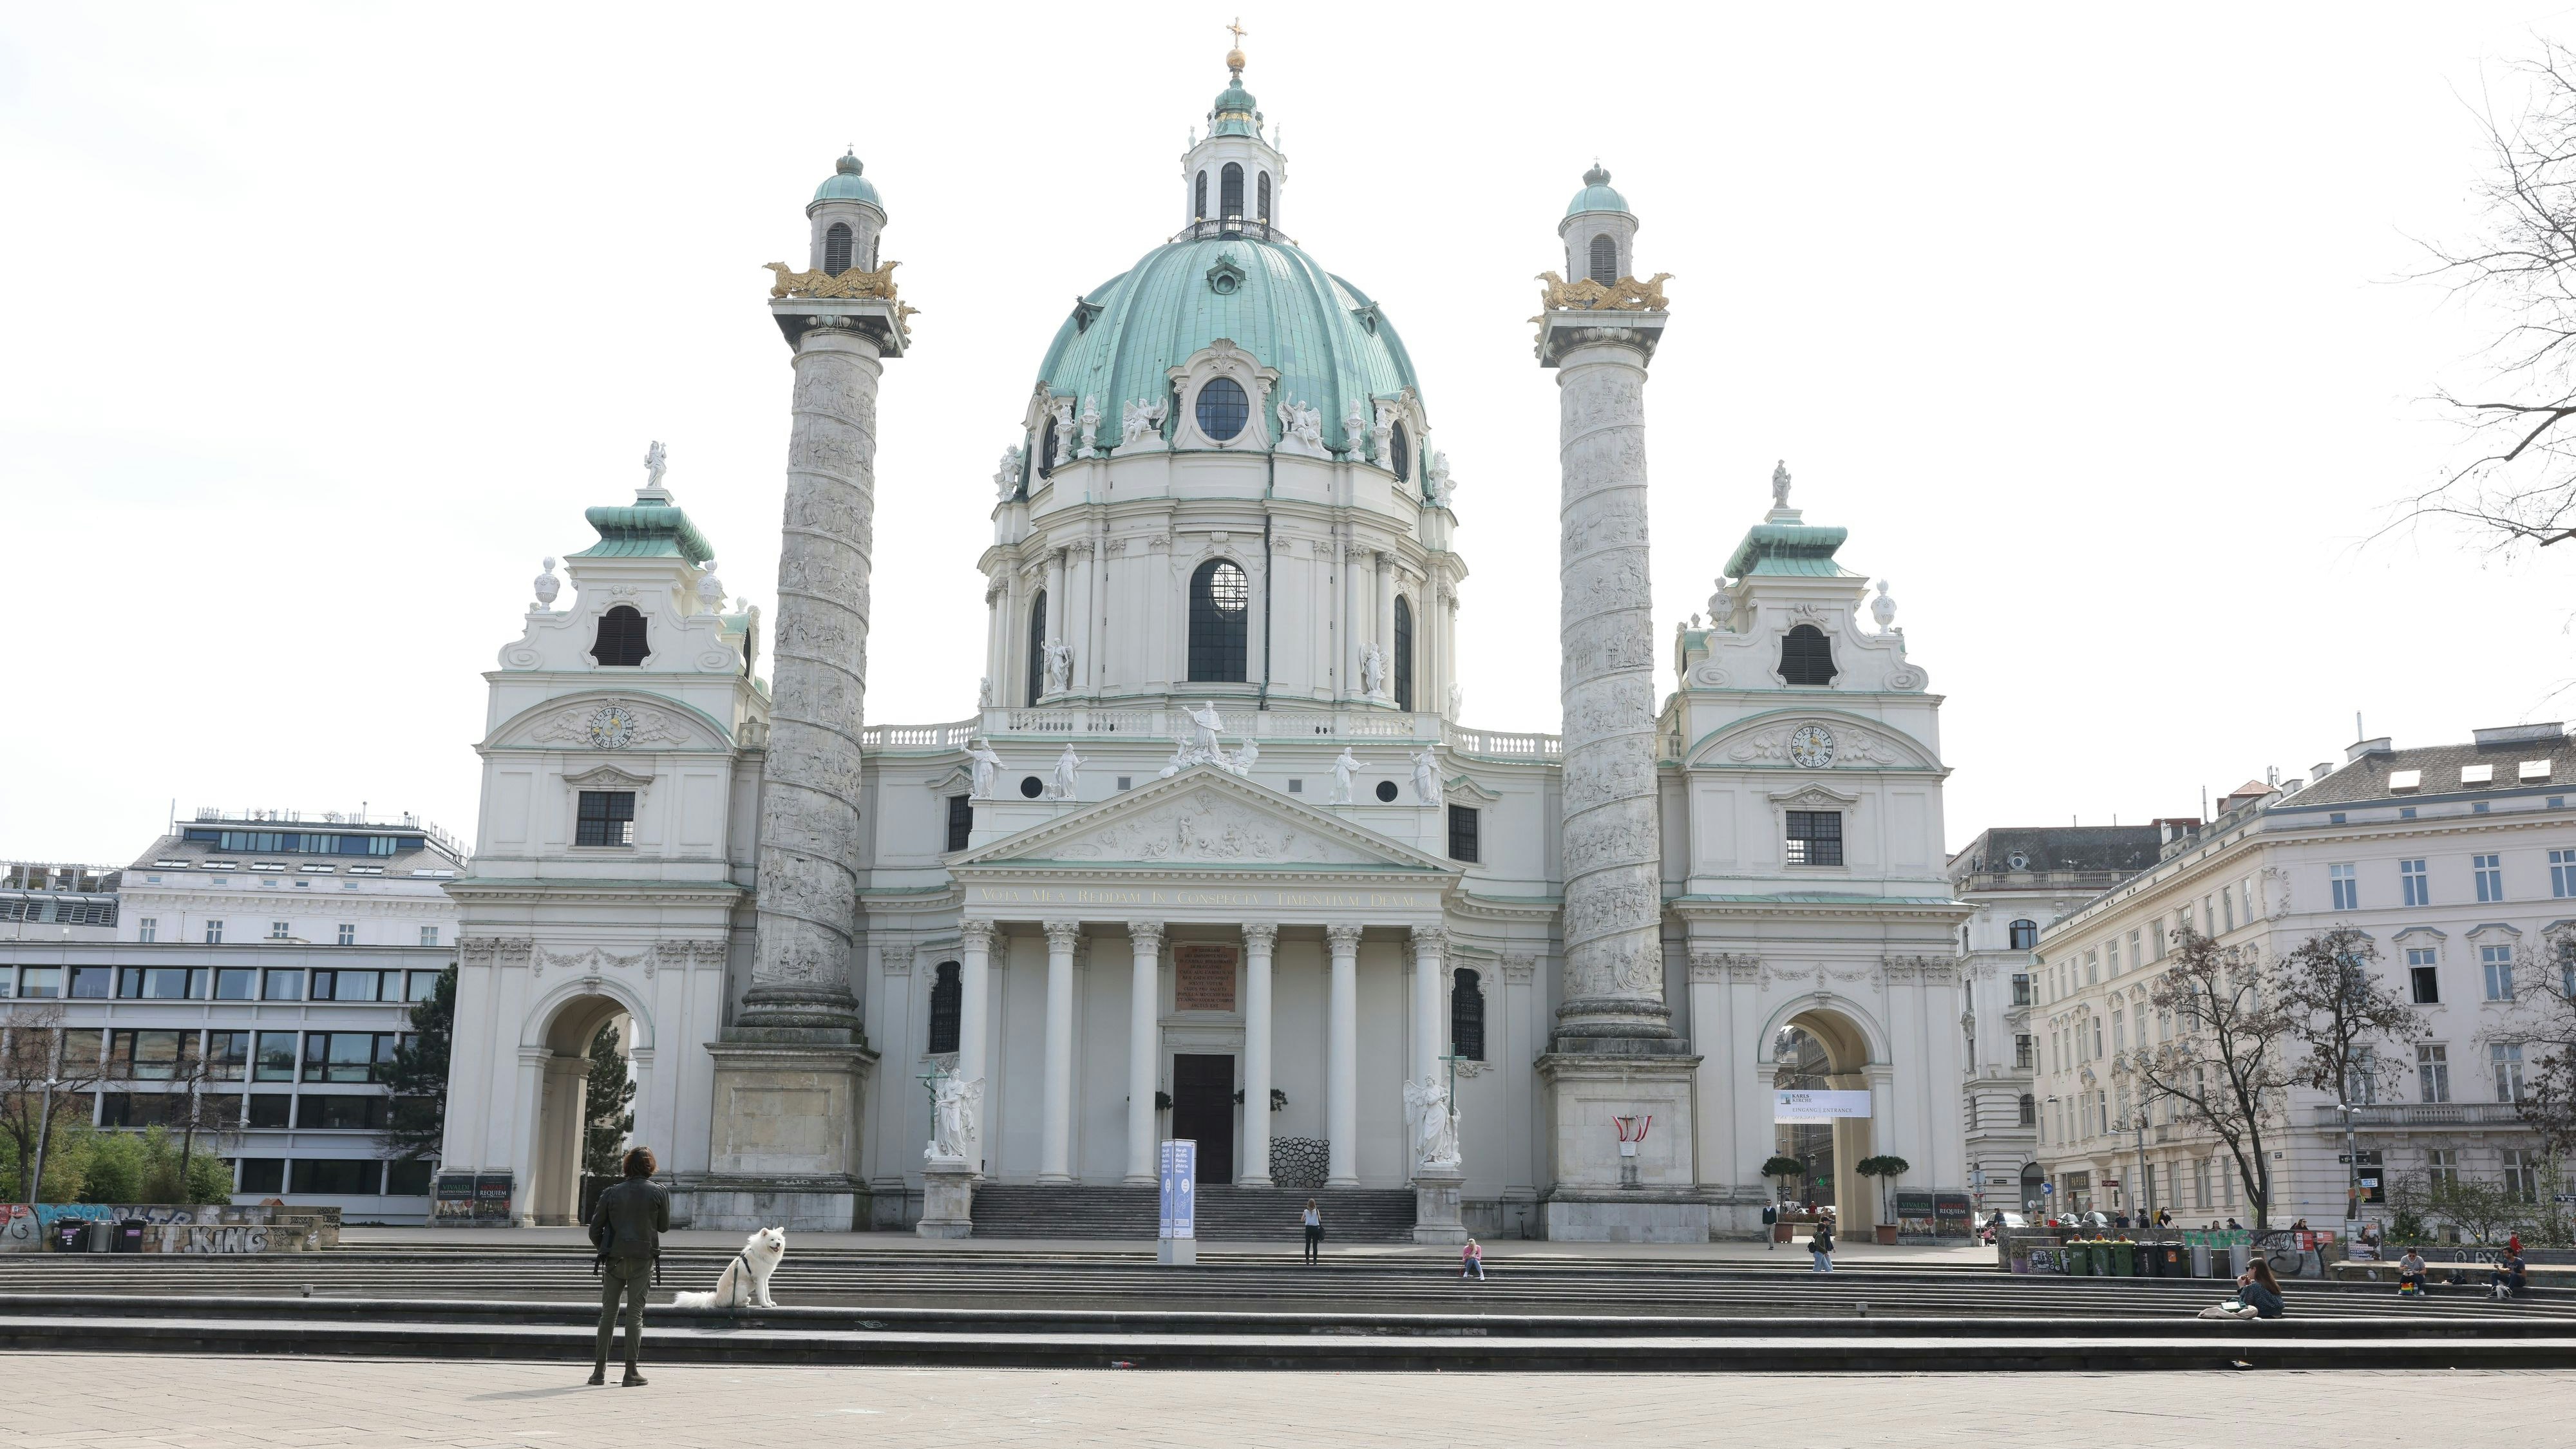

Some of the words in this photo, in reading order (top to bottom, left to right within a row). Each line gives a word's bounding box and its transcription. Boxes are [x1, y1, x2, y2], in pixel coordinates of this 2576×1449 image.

[981, 889, 1020, 902] VOTA
[1032, 889, 1066, 902] MEA
[1078, 890, 1141, 903] REDDAM
[1153, 891, 1166, 903] IN
[1177, 891, 1262, 904] CONSPECTV
[1275, 892, 1359, 906] TIMENTIVM
[1371, 893, 1414, 907] DEVM
[2071, 1176, 2087, 1186] PAPIER
